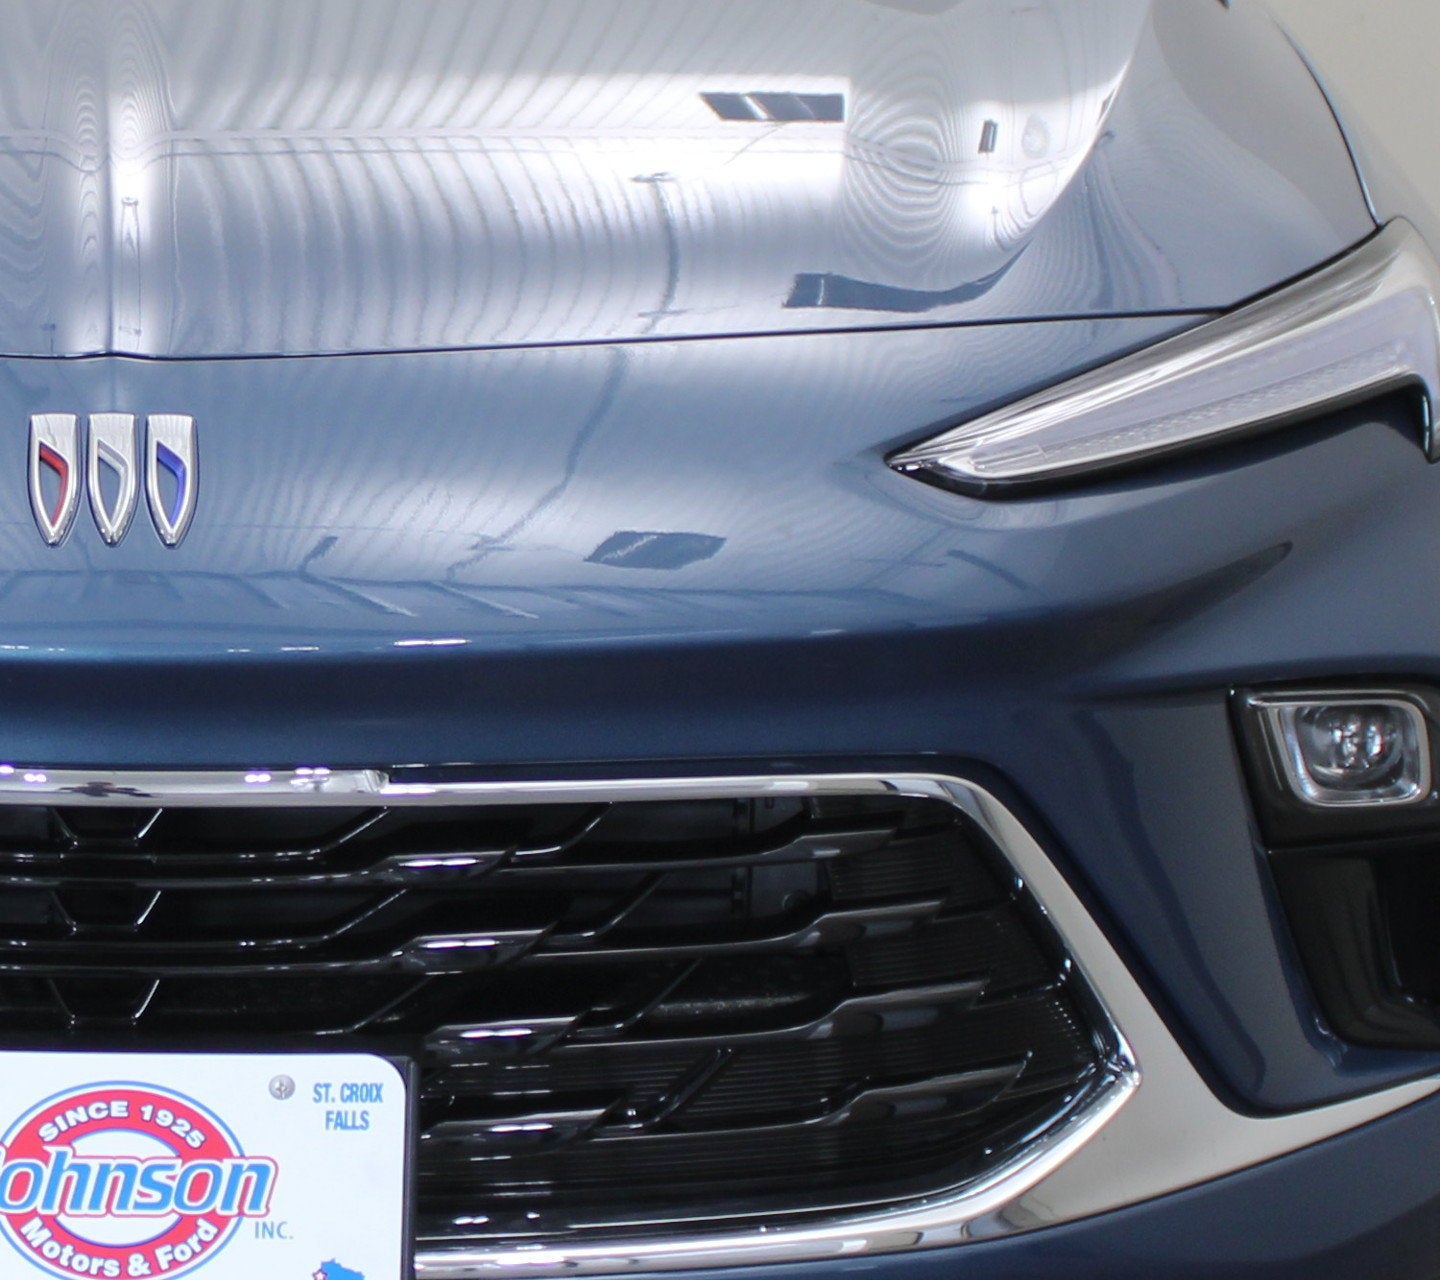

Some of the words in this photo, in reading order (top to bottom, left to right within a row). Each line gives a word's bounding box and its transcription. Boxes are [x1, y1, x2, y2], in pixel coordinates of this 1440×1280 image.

[312, 1082, 335, 1103] ST.
[340, 1082, 384, 1103] CROIX
[37, 1100, 130, 1142] SINCE
[140, 1104, 207, 1148] 1925
[325, 1110, 370, 1131] FALLS
[253, 1221, 294, 1240] INC.
[19, 1216, 121, 1278] Motors
[127, 1252, 152, 1277] &
[154, 1217, 220, 1271] Ford
